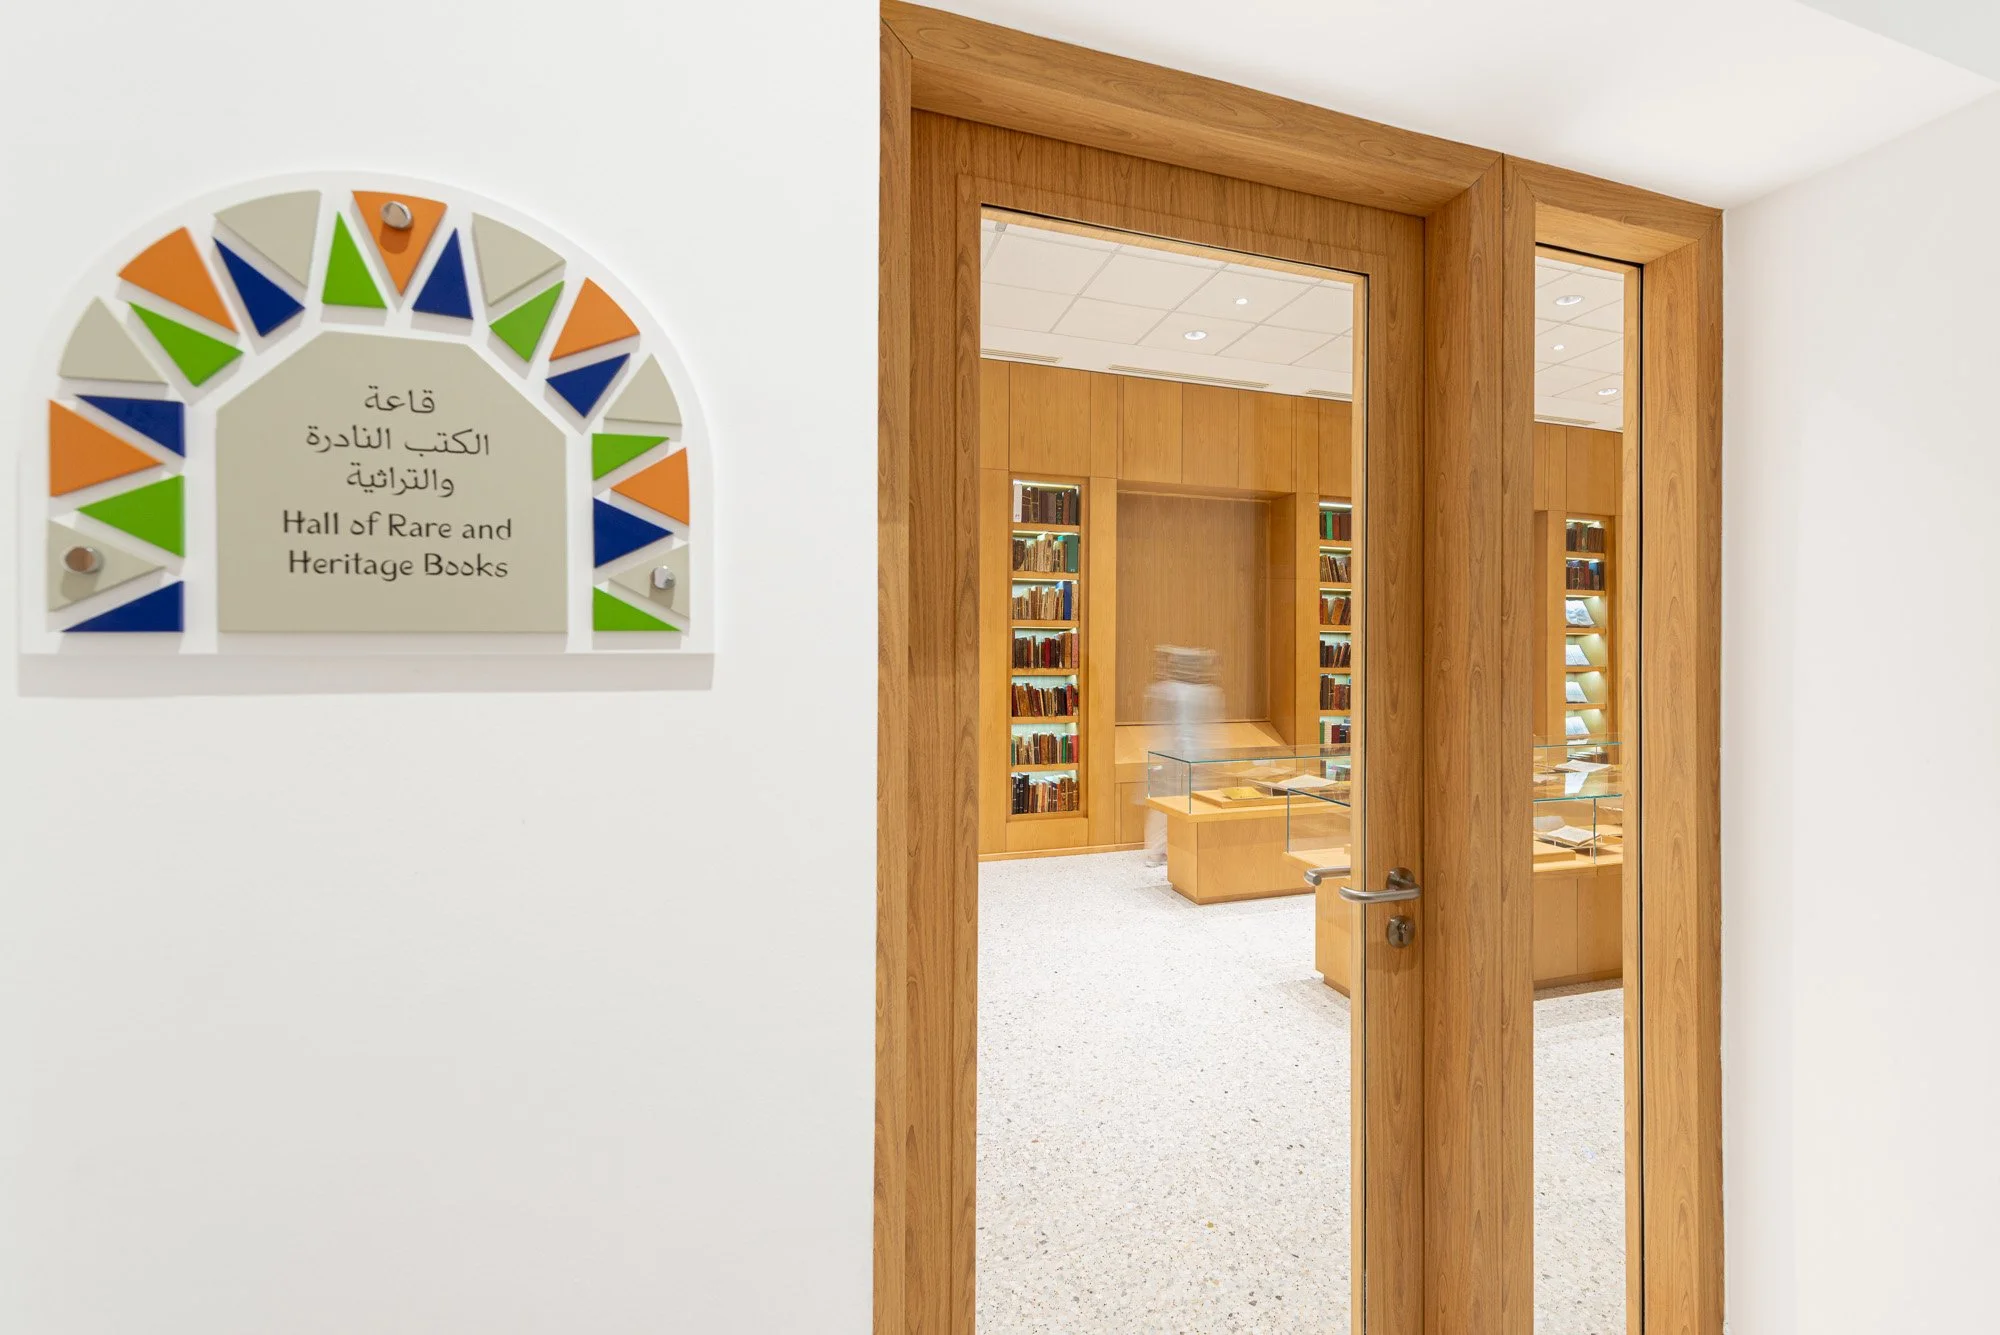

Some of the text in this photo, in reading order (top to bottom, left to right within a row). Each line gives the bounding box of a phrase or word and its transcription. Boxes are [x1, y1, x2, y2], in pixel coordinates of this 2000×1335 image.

[364, 384, 436, 414] قاعة
[305, 424, 490, 458] الكتب النادرة
[346, 461, 455, 499] والتراثية
[282, 509, 512, 541] Hall of Rare and
[288, 549, 509, 583] Heritage Books
